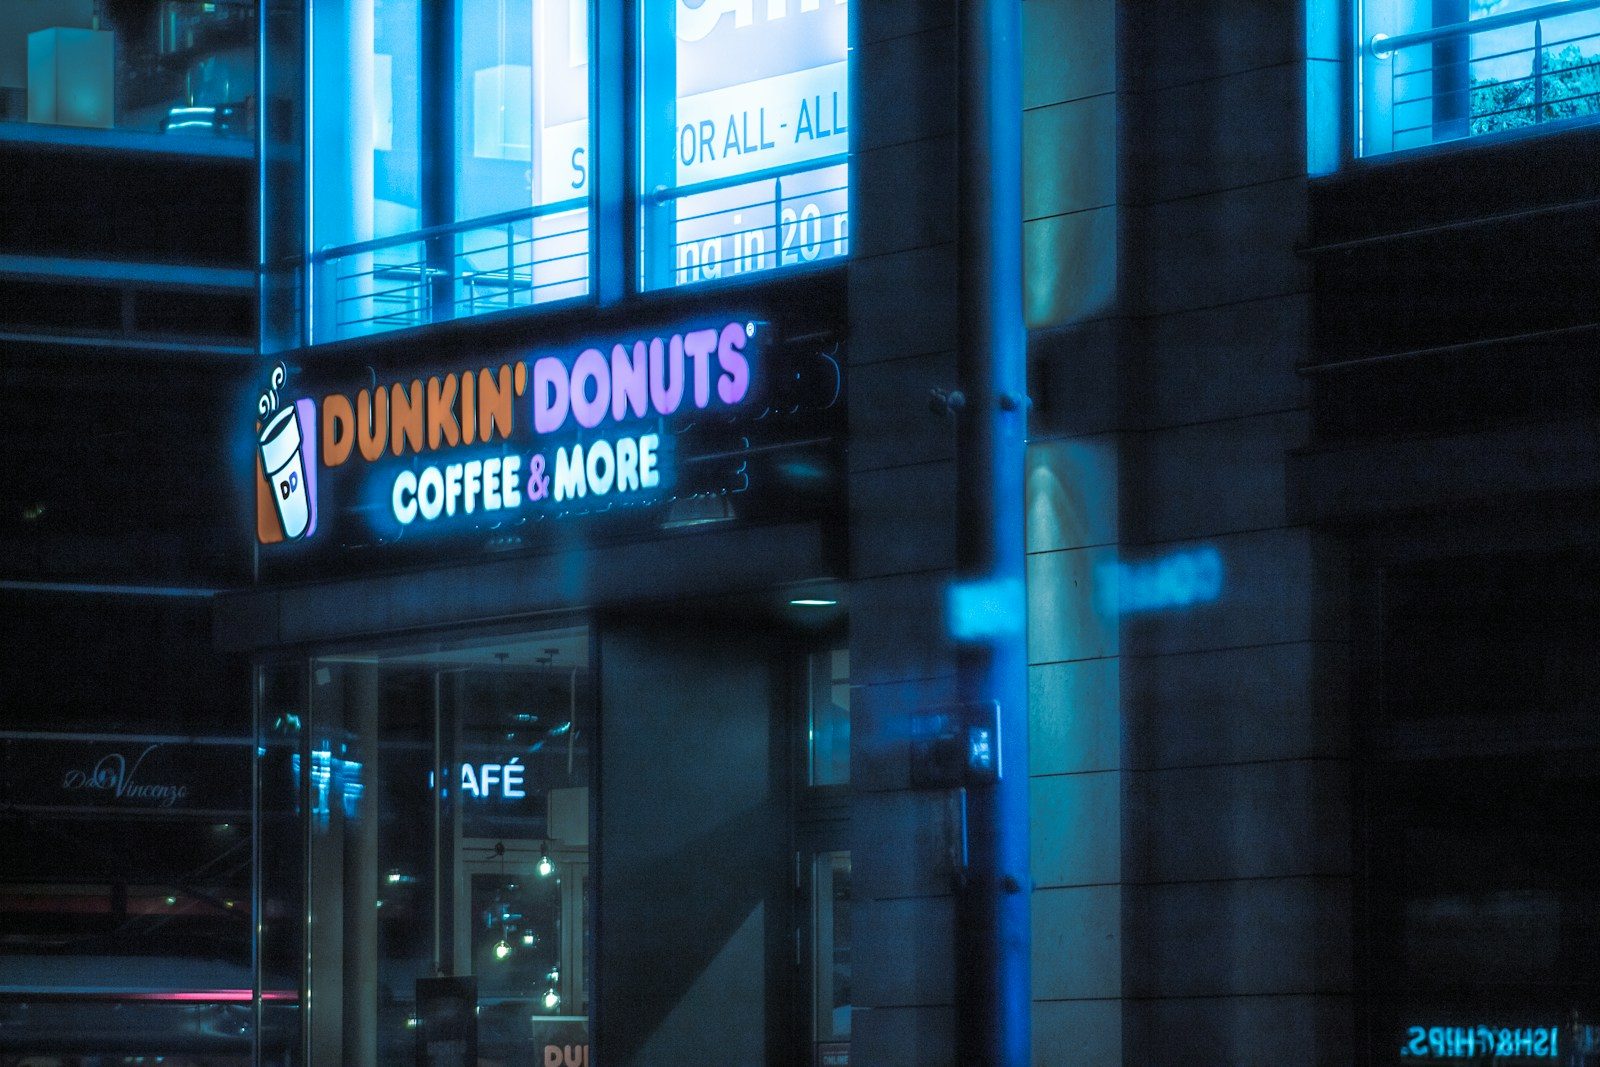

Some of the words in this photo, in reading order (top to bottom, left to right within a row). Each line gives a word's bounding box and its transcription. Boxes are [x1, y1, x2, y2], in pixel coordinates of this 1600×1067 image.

[676, 119, 716, 166] OR
[723, 107, 775, 159] ALL
[794, 91, 848, 143] ALL
[733, 213, 765, 274] in
[780, 203, 822, 265] 20
[322, 361, 528, 467] DUNKIN'
[280, 471, 298, 500] DD
[392, 454, 522, 525] COFFEE
[526, 453, 550, 501] &
[554, 433, 660, 502] MORE
